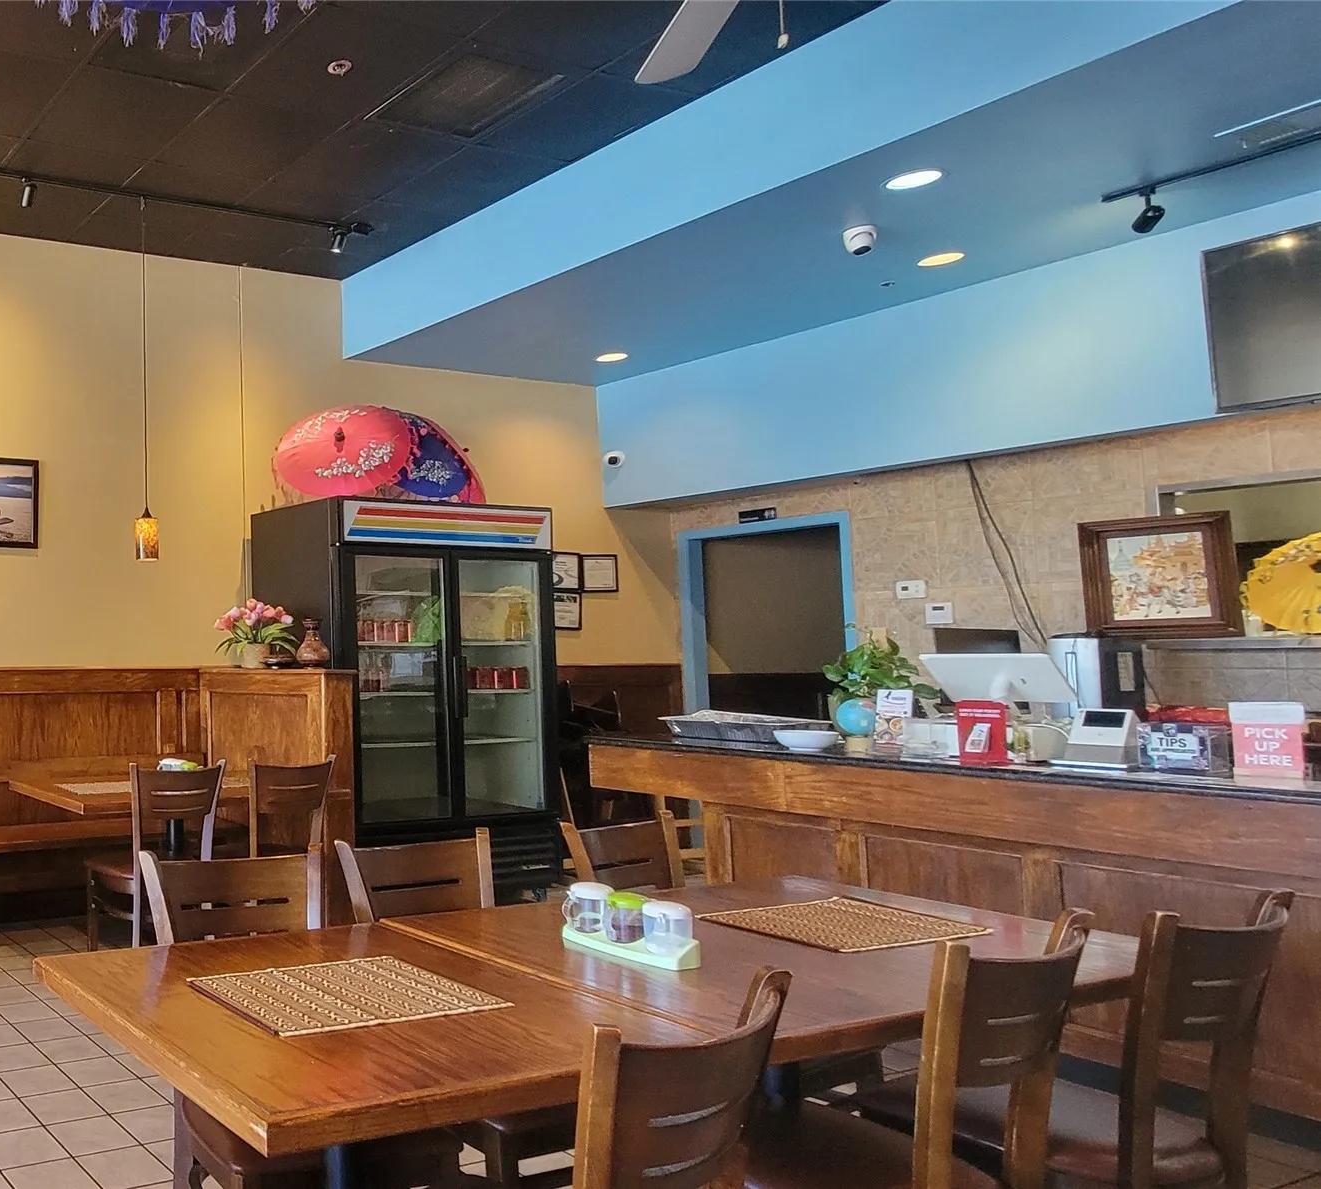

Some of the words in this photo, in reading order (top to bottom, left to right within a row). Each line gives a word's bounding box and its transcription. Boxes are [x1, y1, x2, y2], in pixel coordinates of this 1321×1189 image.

[1244, 727, 1288, 739] PICK
[1157, 737, 1187, 748] TIPS
[1254, 741, 1279, 751] UP
[1244, 754, 1293, 766] HERE
